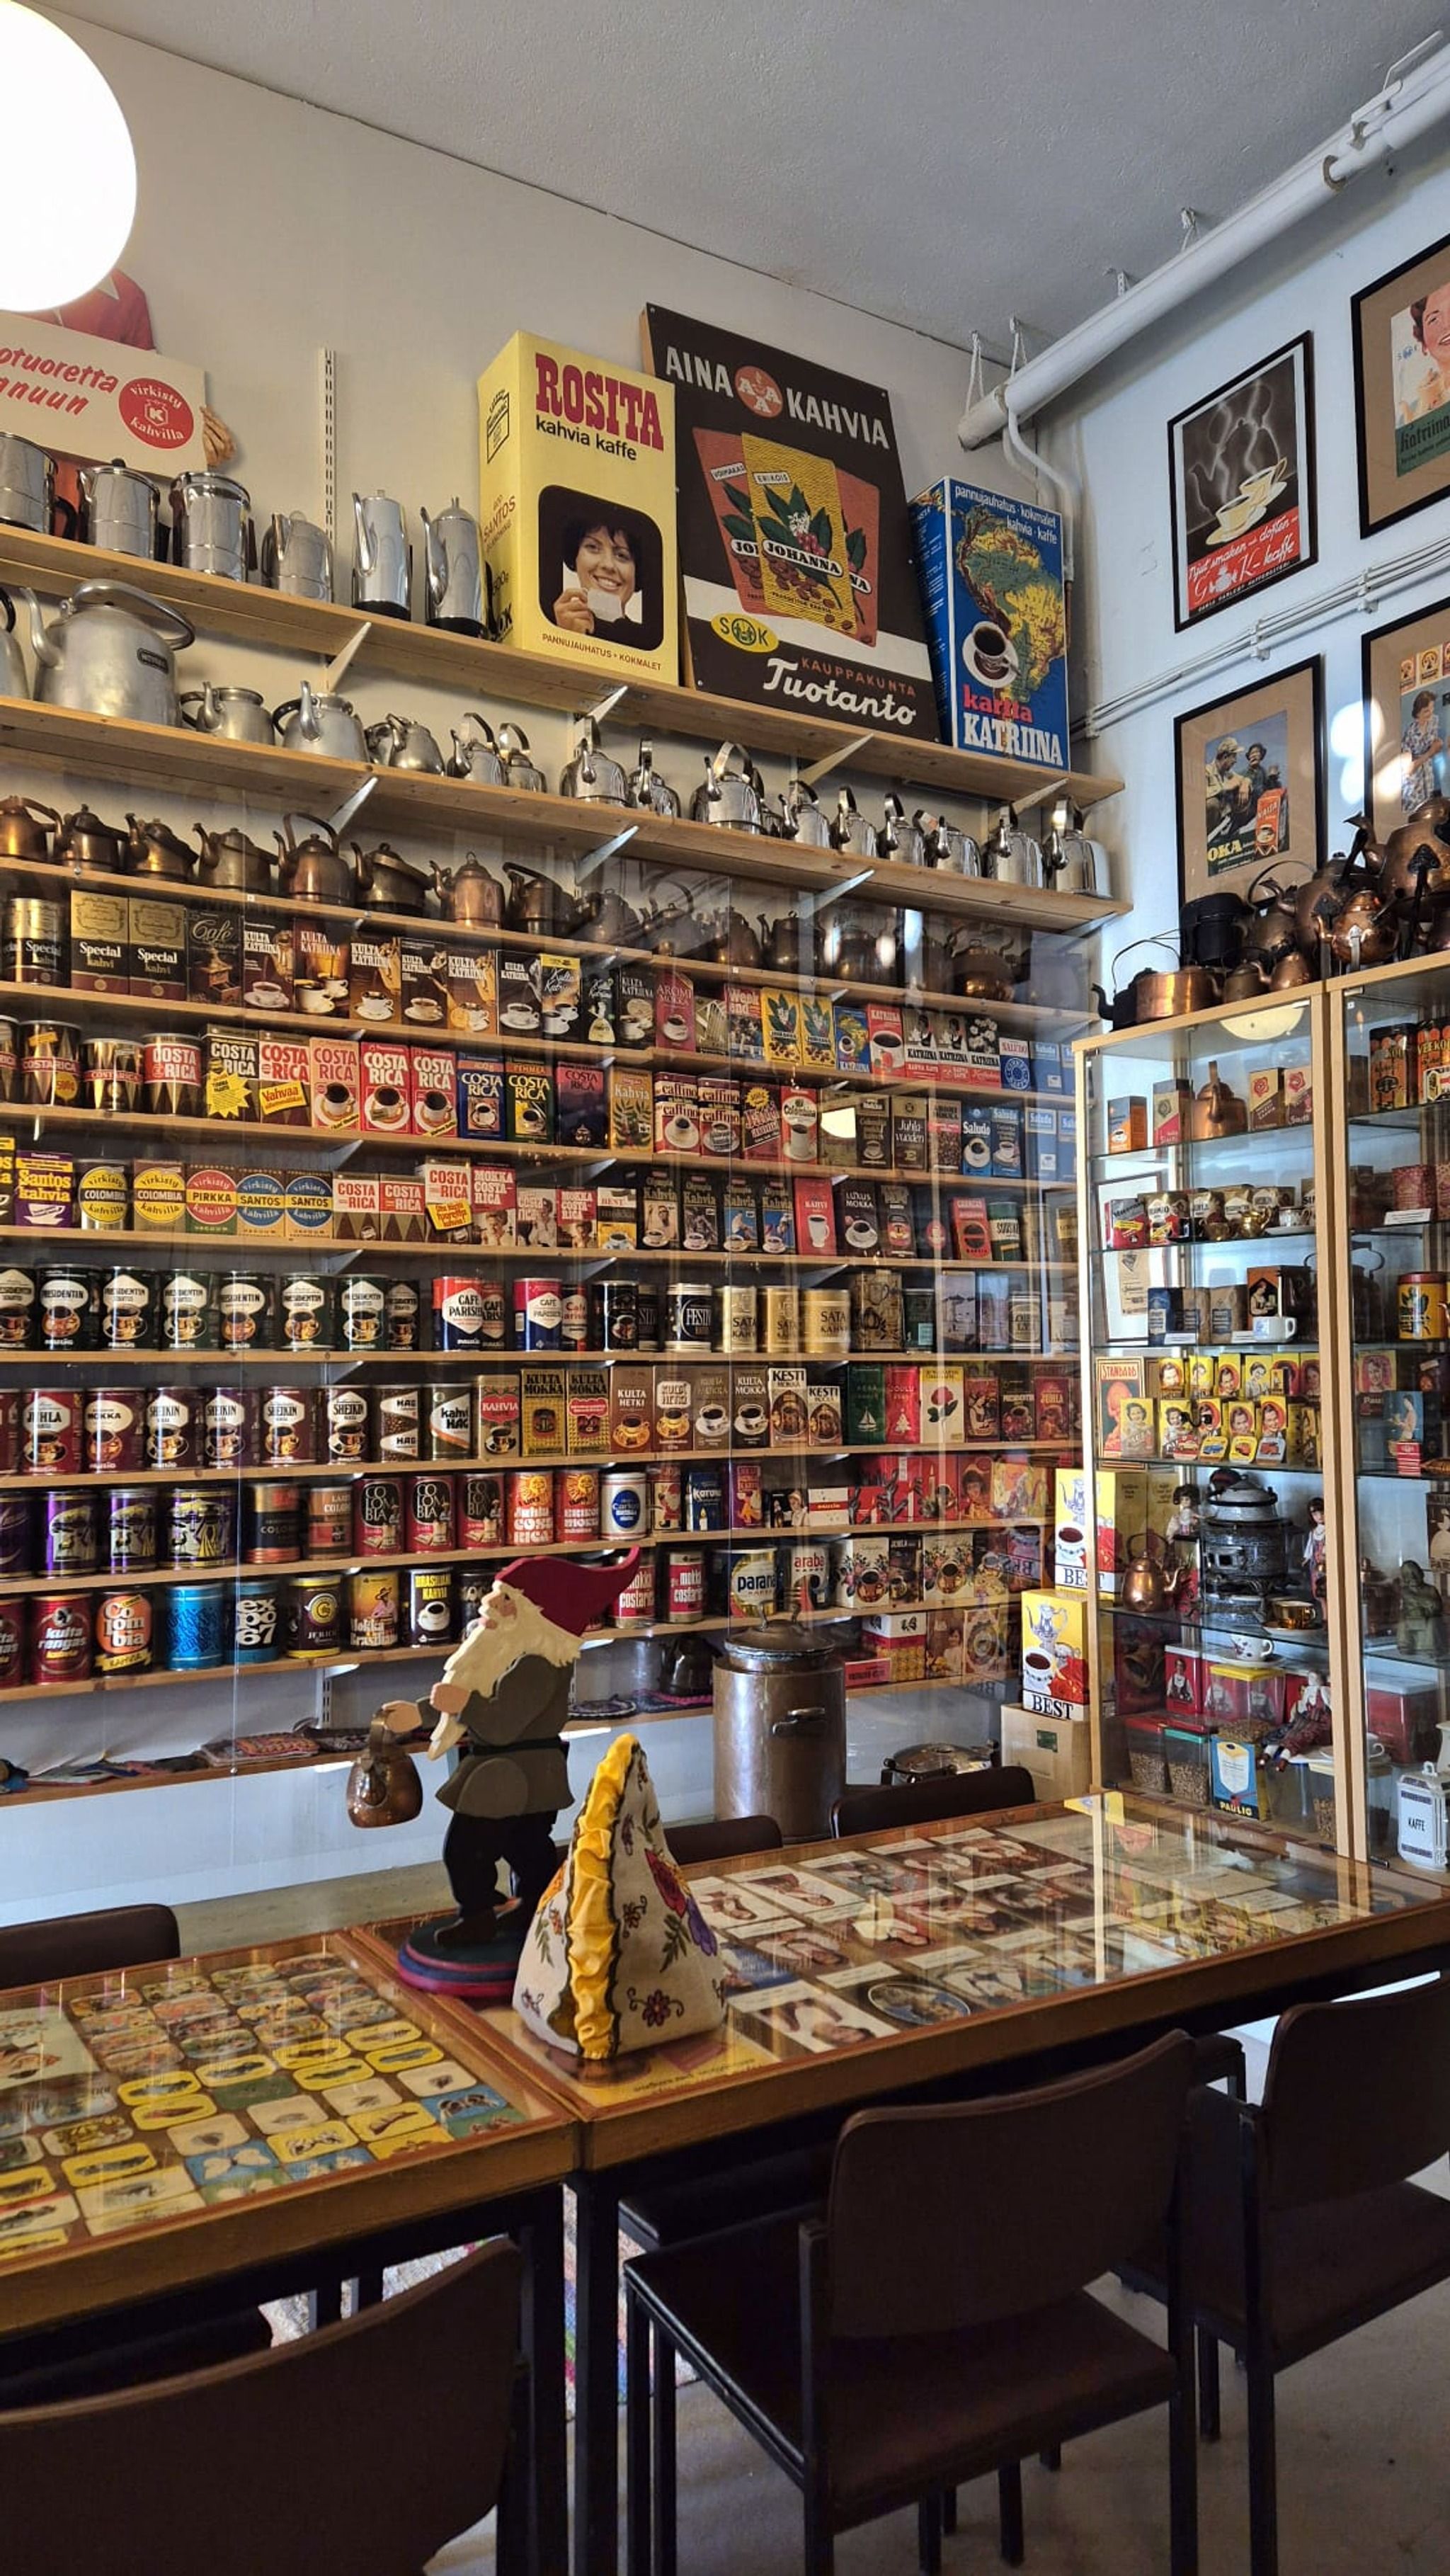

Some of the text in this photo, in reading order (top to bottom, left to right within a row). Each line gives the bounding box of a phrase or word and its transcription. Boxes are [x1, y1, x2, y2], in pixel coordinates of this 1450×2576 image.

[535, 353, 663, 451] ROSITA
[666, 346, 889, 449] AINA KAHVIA
[536, 414, 637, 461] kahvia kaffe
[955, 485, 1015, 515] pannujauhatus
[1007, 515, 1057, 545] kahvia kaffe
[766, 542, 840, 574] JOHANNA
[542, 634, 612, 659] PANNUJAUHATUS
[801, 657, 916, 697] KAUPPAKUNTA
[763, 657, 916, 725] Tuotanto
[964, 712, 1063, 767] KATRIINA
[1208, 840, 1243, 861] OKA
[244, 930, 270, 944] KULTA
[300, 931, 327, 944] KULTA
[80, 942, 120, 958] Special
[244, 942, 279, 954] KATRIINA
[301, 942, 341, 957] KATRIINA
[351, 942, 379, 956] KULTA
[138, 948, 177, 964] Special
[351, 955, 389, 969] KATRIINA
[152, 1047, 197, 1066] COSTA
[211, 1042, 256, 1062] COSTA
[262, 1044, 309, 1066] COSTA
[314, 1048, 357, 1066] COSTA
[908, 1049, 937, 1060] KATRIINA
[939, 1051, 968, 1062] KATRIINA
[363, 1052, 409, 1071] COSTA
[413, 1056, 455, 1075] COSTA
[971, 1055, 1000, 1066] KATRIINA
[165, 1063, 197, 1080] RICA
[224, 1059, 256, 1076] RICA
[272, 1064, 309, 1082] RICA
[320, 1064, 353, 1081] RICA
[370, 1068, 404, 1085] RICA
[419, 1072, 451, 1090] RICA
[462, 1073, 503, 1087] COSTA
[509, 1076, 549, 1090] COSTA
[566, 1071, 599, 1083] COSTA
[469, 1085, 499, 1098] RICA
[571, 1082, 595, 1090] RICA
[615, 1084, 650, 1099] Kahvia
[662, 1083, 697, 1098] caffino
[262, 1085, 299, 1103] Vahvaa
[515, 1088, 547, 1100] RICA
[702, 1089, 740, 1103] caffino
[663, 1105, 699, 1118] caffino
[702, 1111, 740, 1124] caffino
[1029, 1112, 1052, 1124] Saludo
[963, 1122, 991, 1135] Saludo
[18, 1170, 71, 1187] Santos
[430, 1170, 468, 1185] COSTA
[474, 1170, 513, 1183] MOKKA
[18, 1187, 70, 1202] kahvia
[84, 1190, 125, 1199] COLOMBIA
[137, 1190, 182, 1200] COLOMBIA
[338, 1183, 375, 1196] COSTA
[385, 1185, 421, 1199] COSTA
[440, 1185, 468, 1199] RICA
[193, 1192, 232, 1202] PIRKKA
[241, 1195, 280, 1206] SANTOS
[292, 1197, 328, 1207] SANTOS
[348, 1197, 375, 1209] RICA
[474, 1193, 501, 1204] RICA
[683, 1191, 716, 1205] Kahvia
[724, 1195, 755, 1207] Kahvia
[142, 1202, 180, 1214] kahvilla
[193, 1204, 229, 1215] kahvilla
[395, 1199, 421, 1211] RICA
[244, 1207, 279, 1219] kahvilla
[294, 1209, 326, 1220] kahvilla
[733, 1317, 756, 1327] SATA
[821, 1311, 845, 1322] SATA
[773, 1371, 804, 1381] KESTI
[1102, 1363, 1136, 1377] STANDARD
[527, 1375, 560, 1384] KULTA
[572, 1375, 604, 1384] KULTA
[738, 1377, 763, 1386] KULTA
[525, 1384, 564, 1394] MOKKA
[569, 1384, 607, 1394] MOKKA
[618, 1389, 646, 1399] KULTA
[735, 1386, 766, 1394] MOKKA
[809, 1388, 838, 1396] KESTI
[149, 1405, 180, 1415] SHEIKIN
[207, 1405, 236, 1415] SHEIKIN
[268, 1406, 297, 1415] SHEIKIN
[333, 1404, 365, 1415] SHEIKIN
[441, 1408, 469, 1418] kahvi
[483, 1402, 518, 1411] KAHVIA
[27, 1412, 62, 1423] JUHLA
[447, 1418, 469, 1429] HAG
[365, 1509, 387, 1521] BIA
[417, 1506, 436, 1518] BIA
[738, 1573, 775, 1590] parana
[1064, 1567, 1104, 1589] BET
[236, 1598, 275, 1612] ex
[239, 1612, 276, 1625] po
[46, 1628, 82, 1639] kulta
[236, 1623, 276, 1645] 67
[38, 1637, 86, 1651] rengas
[1032, 1694, 1073, 1719] BEST
[1219, 1801, 1252, 1816] PAULIG
[1408, 1817, 1425, 1832] KAFFE
